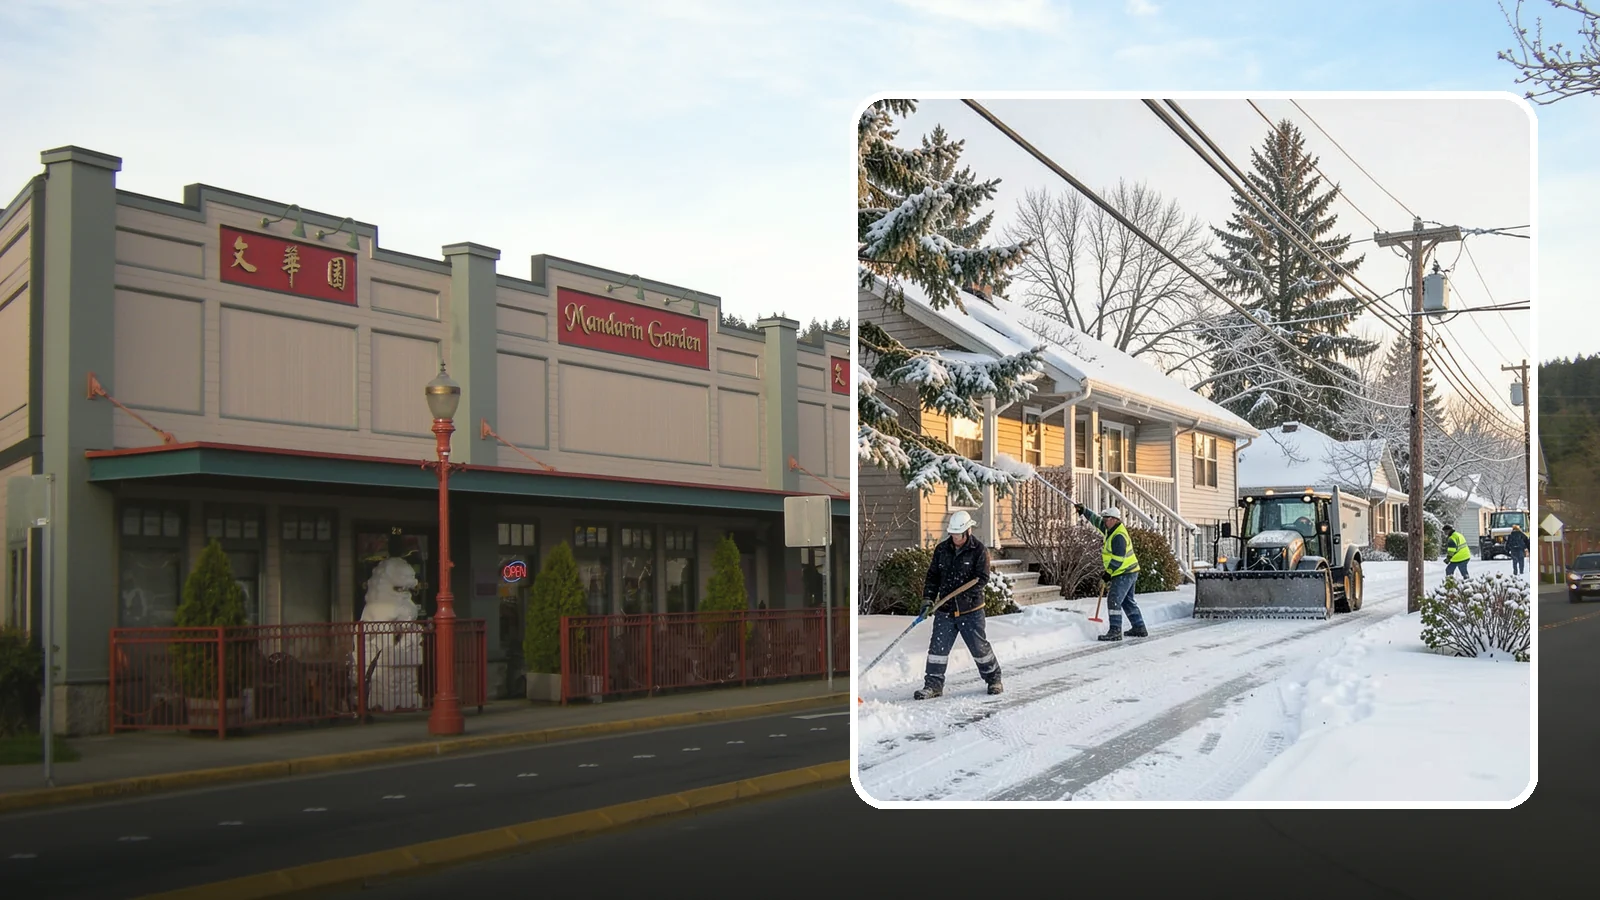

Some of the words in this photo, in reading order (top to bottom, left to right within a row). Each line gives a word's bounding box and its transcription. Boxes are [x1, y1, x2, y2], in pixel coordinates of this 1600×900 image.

[231, 235, 346, 290] 文華園
[565, 302, 643, 341] Mandarin
[648, 320, 701, 352] Garden
[503, 565, 527, 578] OPEN
